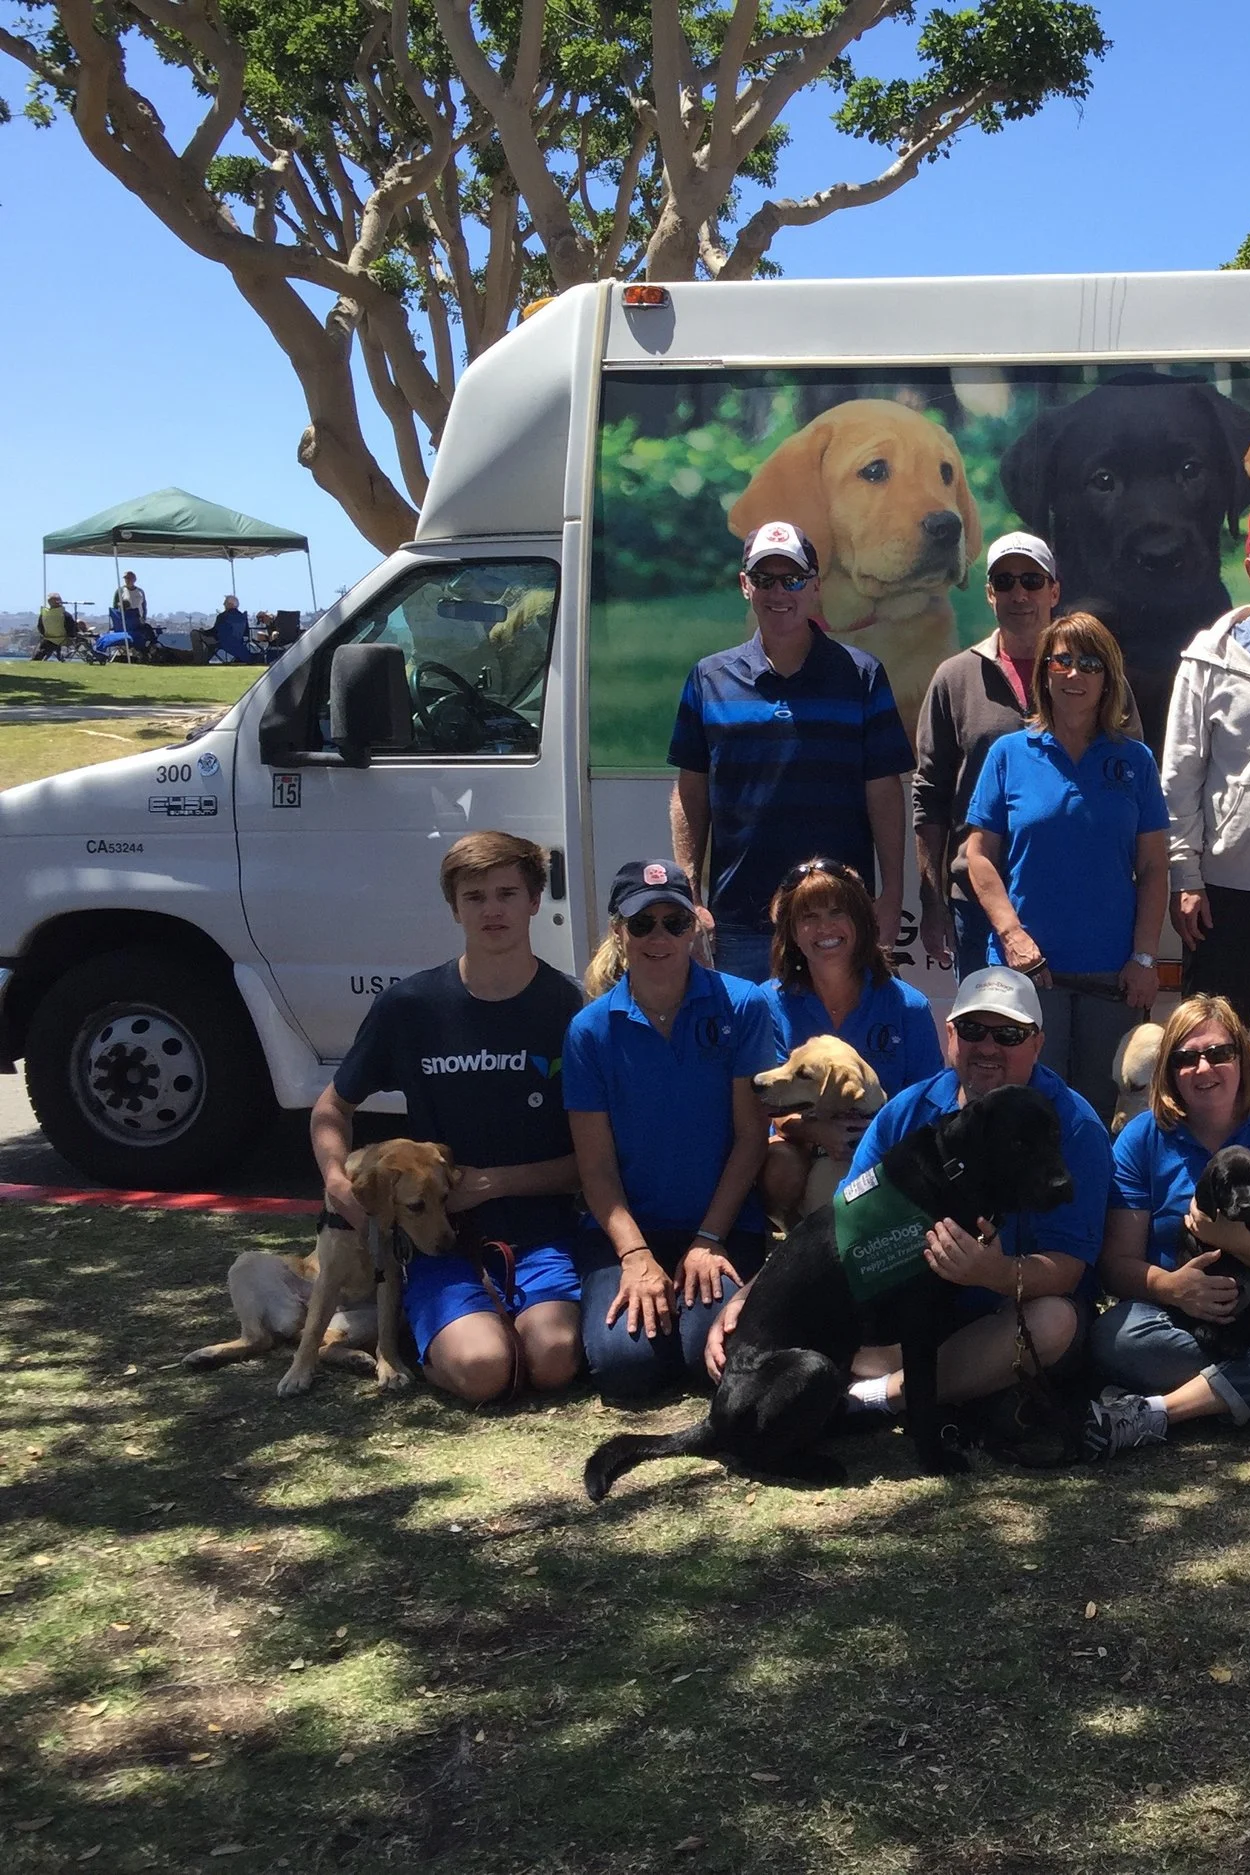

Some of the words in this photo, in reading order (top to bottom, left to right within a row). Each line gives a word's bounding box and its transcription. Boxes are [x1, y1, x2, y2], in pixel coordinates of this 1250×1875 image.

[156, 763, 192, 784] 300
[276, 783, 297, 804] 15
[86, 839, 145, 854] CA53244
[421, 1049, 527, 1075] snowbird
